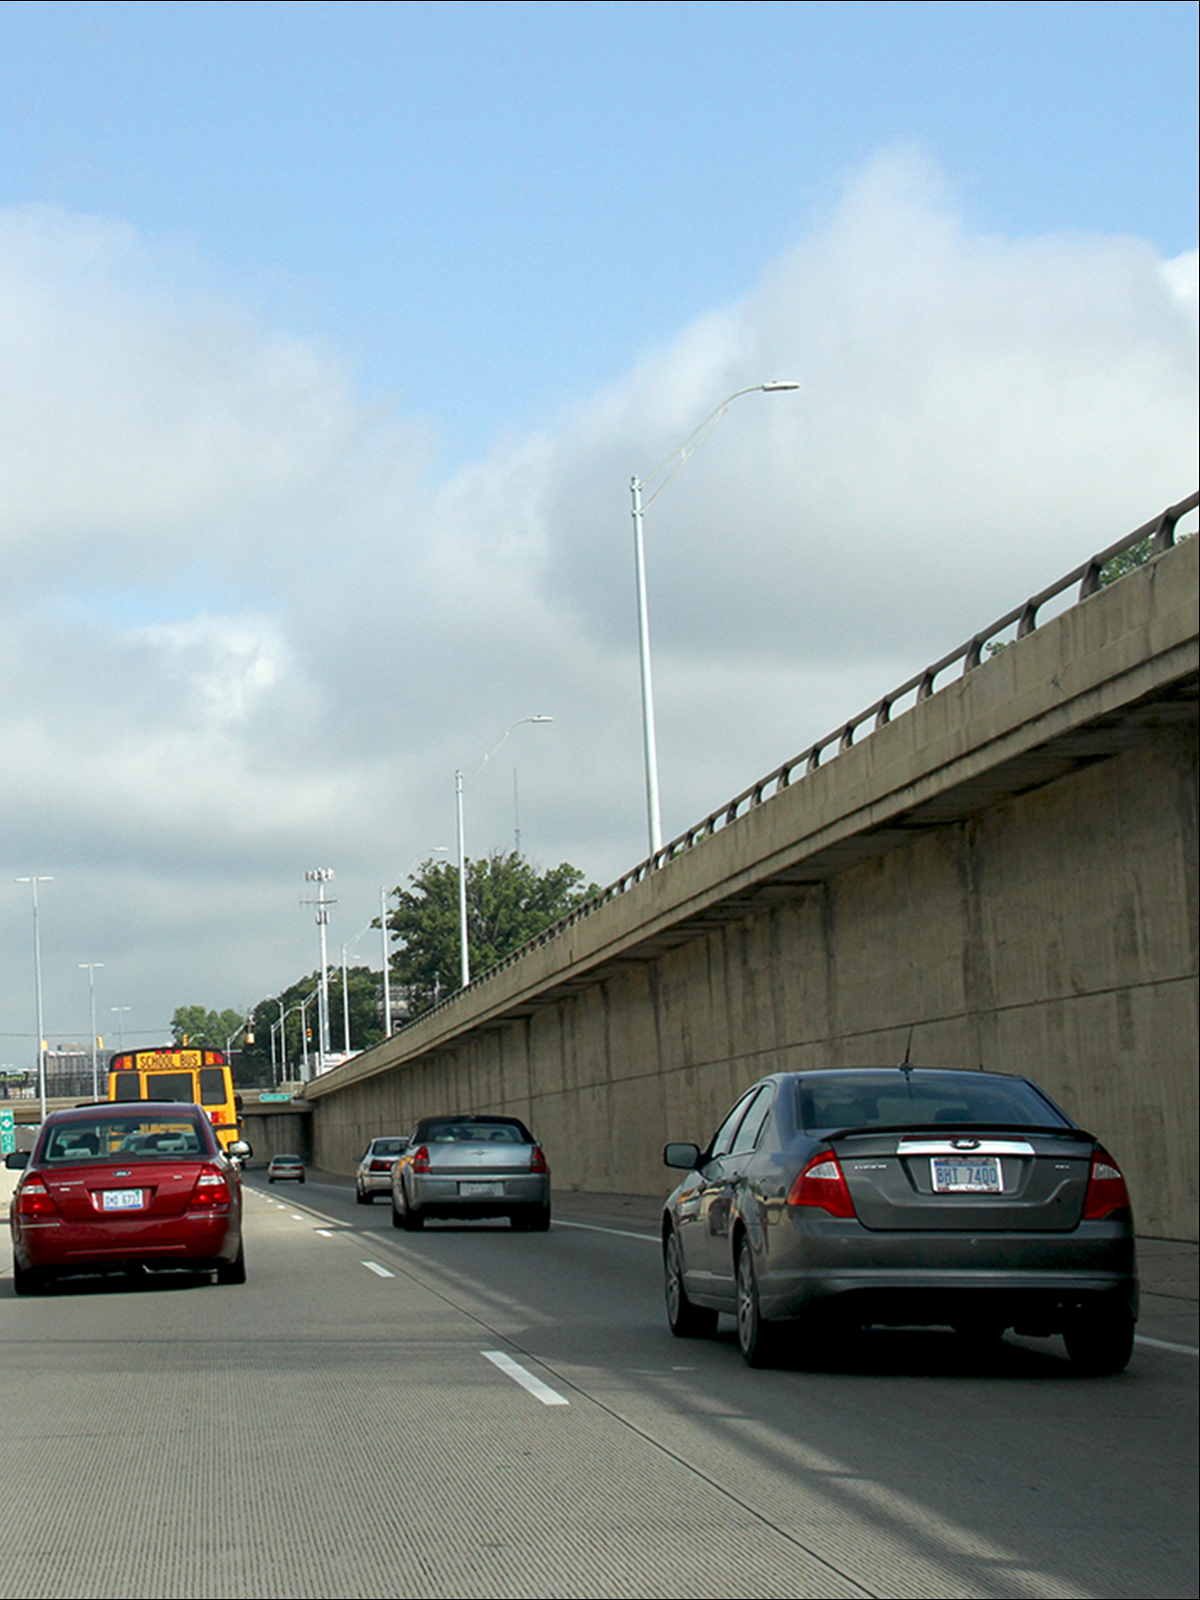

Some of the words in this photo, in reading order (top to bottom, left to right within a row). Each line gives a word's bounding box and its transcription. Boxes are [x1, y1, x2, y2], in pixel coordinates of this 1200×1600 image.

[140, 1054, 175, 1069] SCHOOL
[180, 1053, 199, 1067] BUS
[966, 1167, 997, 1184] 7400
